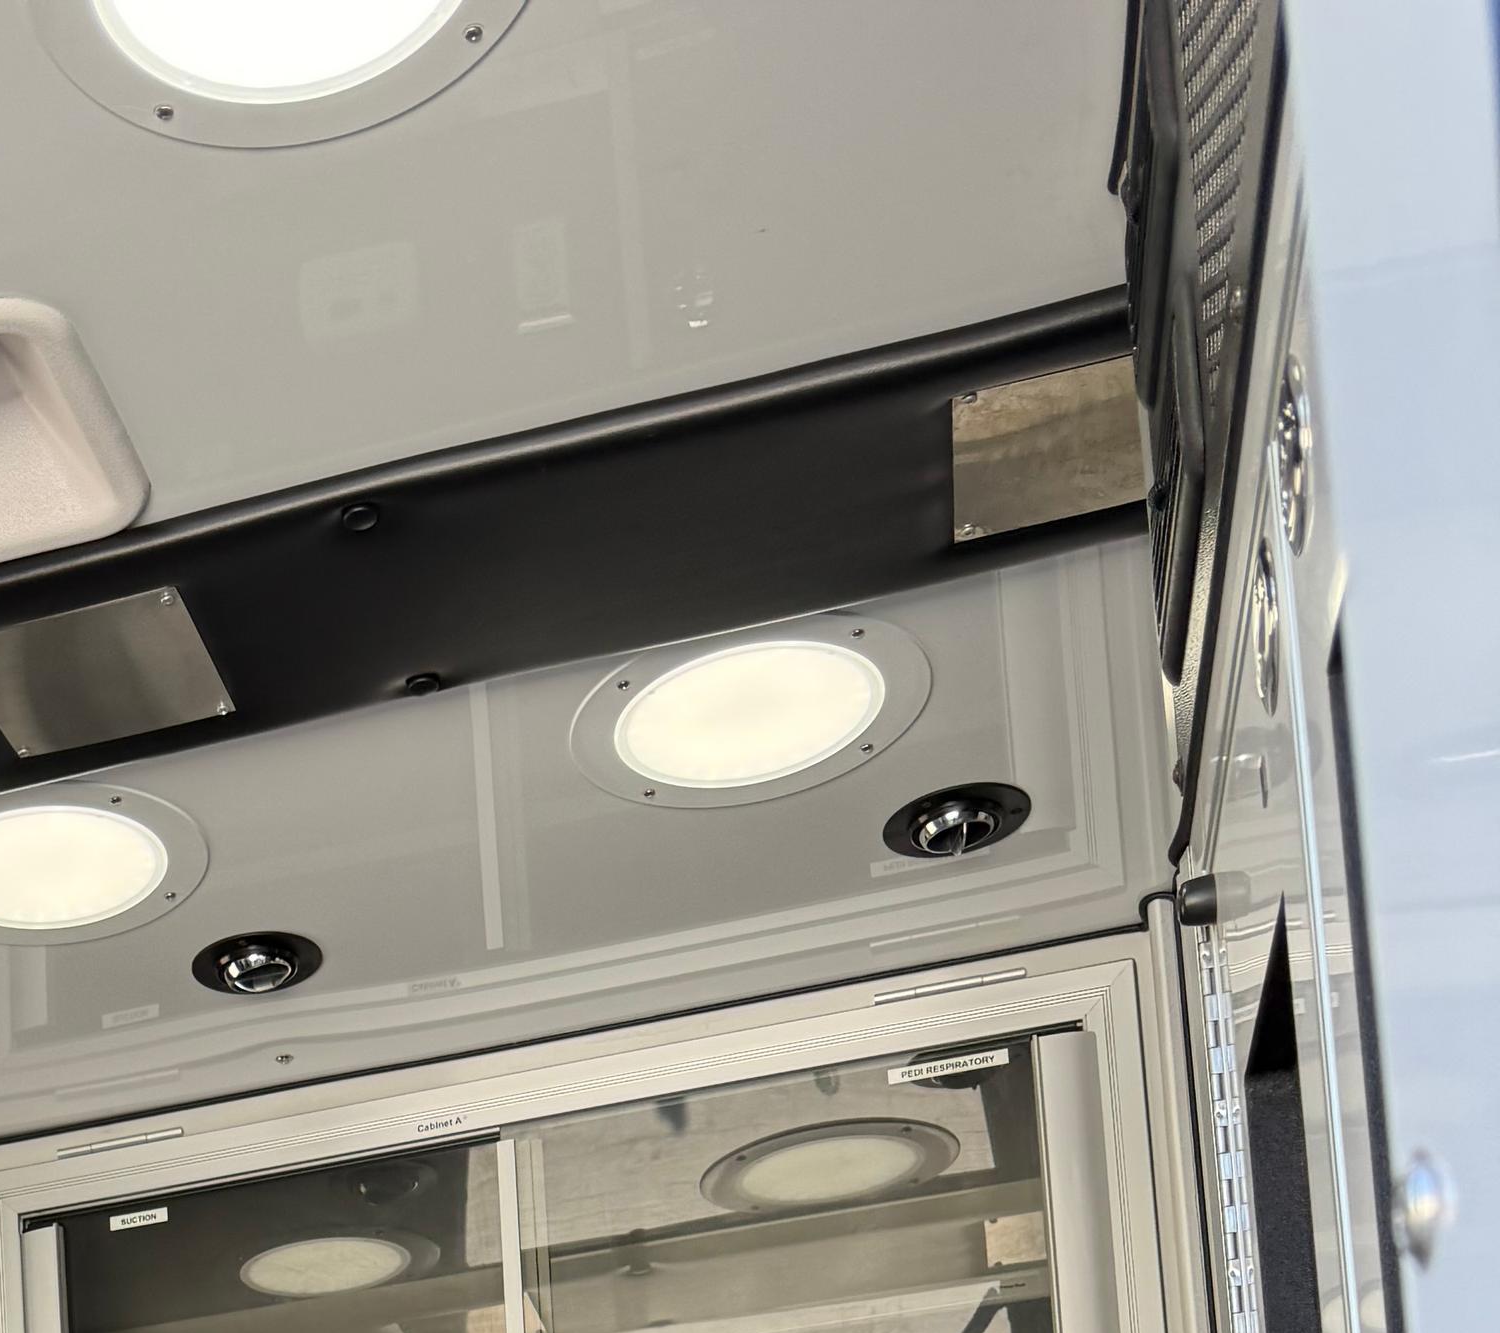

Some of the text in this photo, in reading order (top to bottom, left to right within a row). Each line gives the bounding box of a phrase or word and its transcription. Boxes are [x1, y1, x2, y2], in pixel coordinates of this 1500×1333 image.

[901, 1055, 995, 1079] PEDI RESPIRATORY
[417, 1119, 453, 1133] Cabinet
[121, 1213, 157, 1225] SUCTION
